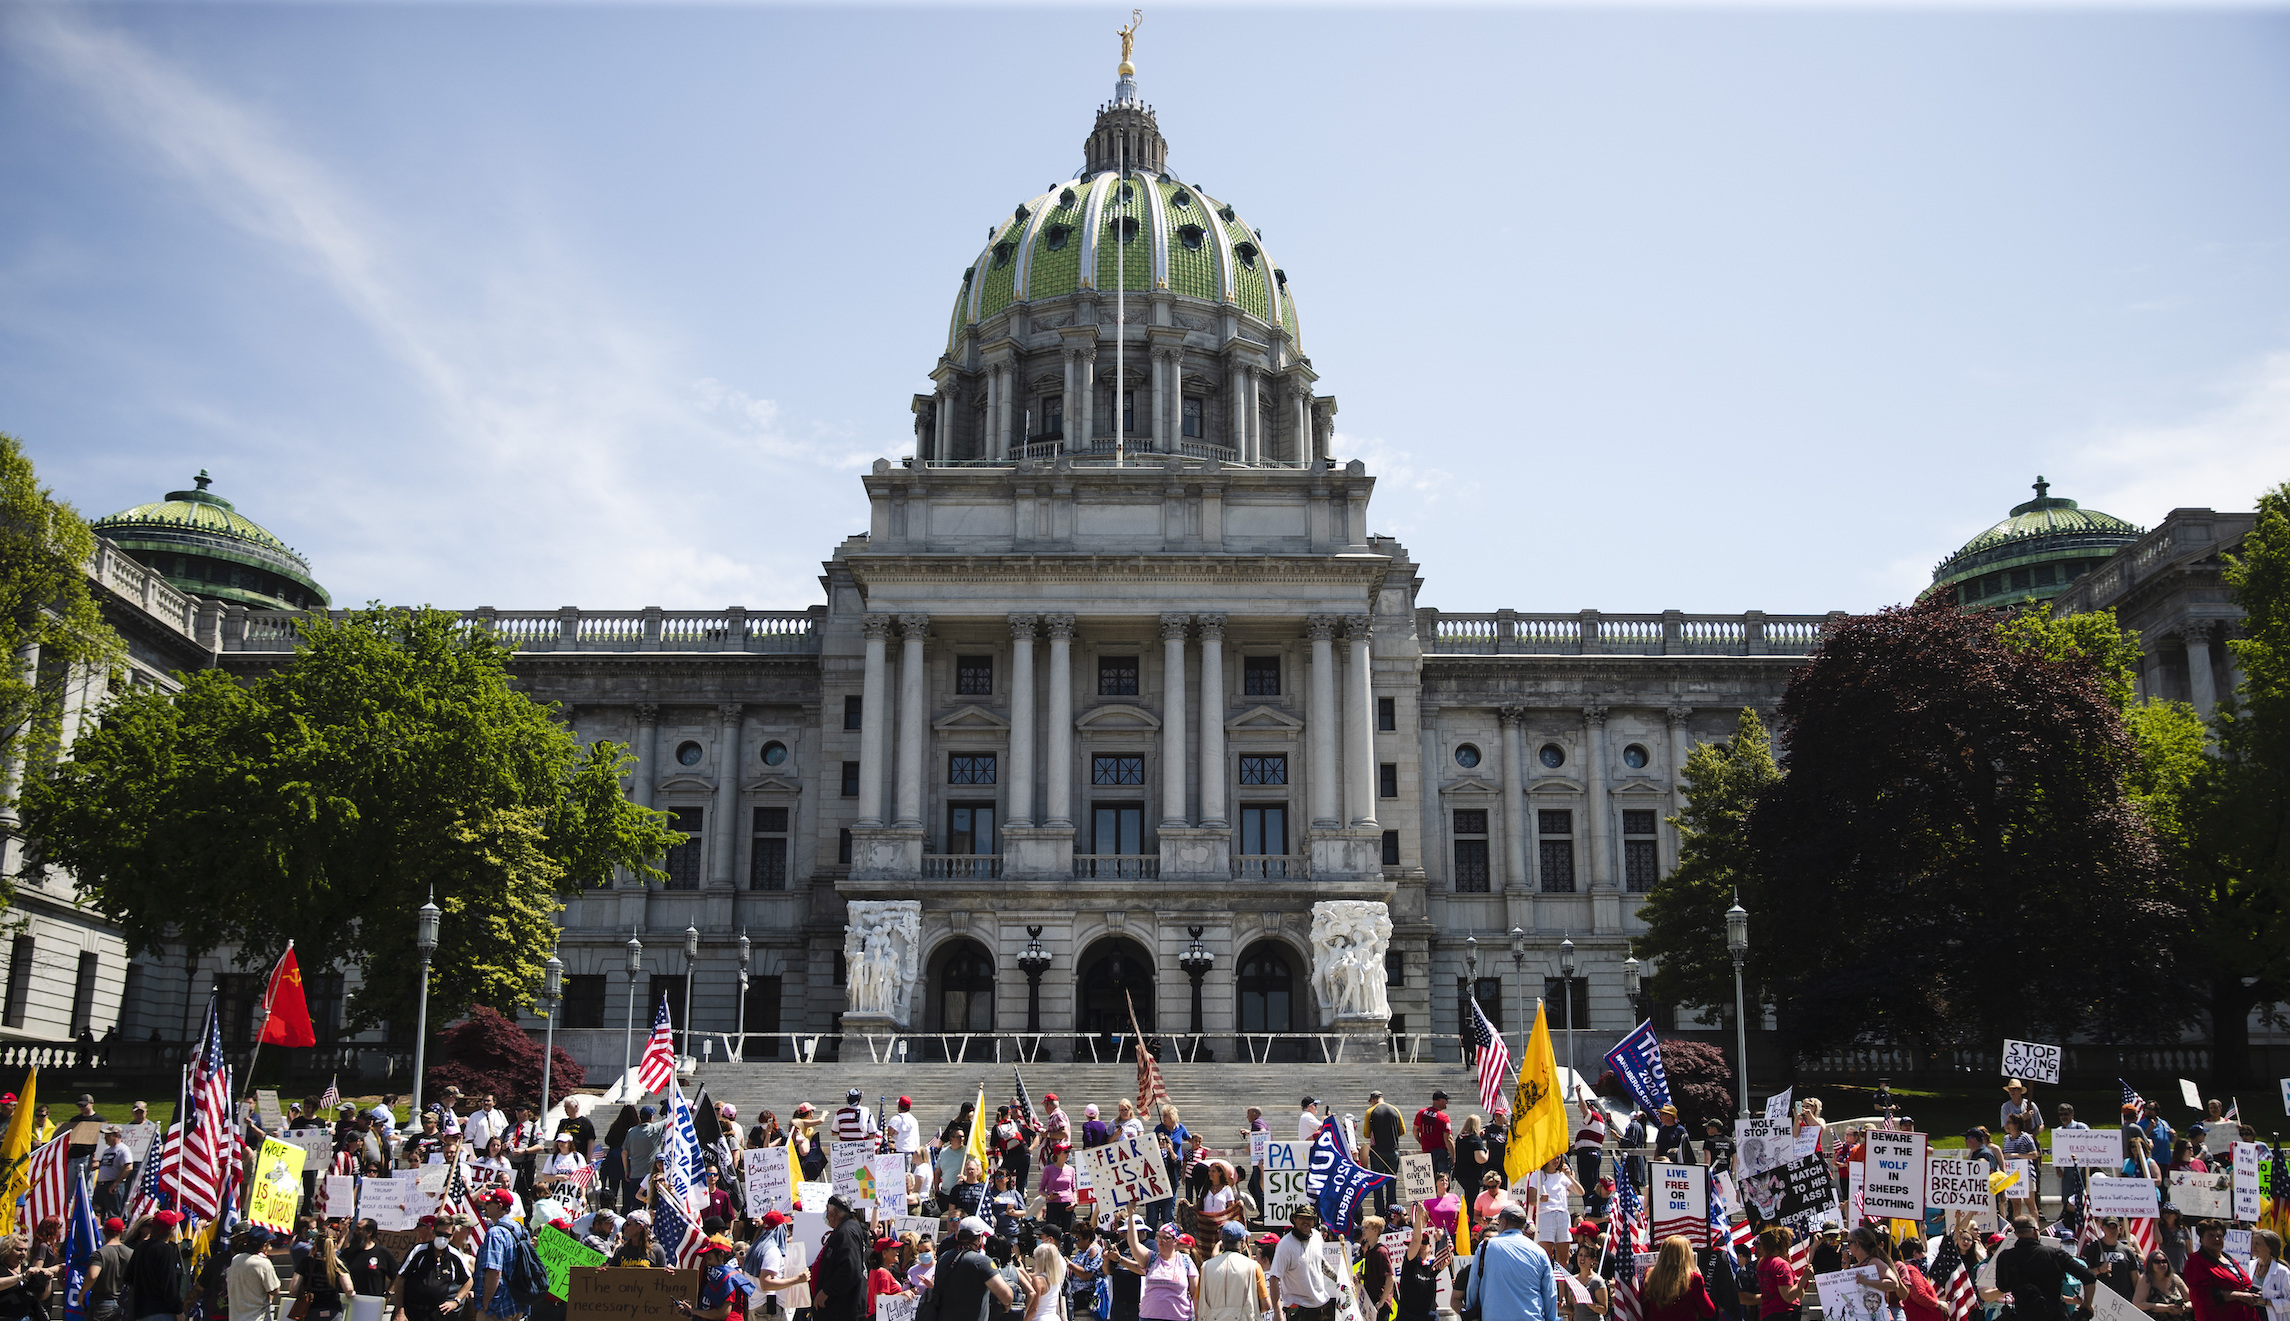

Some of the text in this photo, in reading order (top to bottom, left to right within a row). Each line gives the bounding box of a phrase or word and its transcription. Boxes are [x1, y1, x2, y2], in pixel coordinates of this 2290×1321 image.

[2009, 1043, 2057, 1059] STOP
[2004, 1064, 2058, 1082] WOLF!
[1638, 1069, 1660, 1097] 2020
[1744, 1127, 1769, 1137] STOP
[1772, 1126, 1791, 1136] THE
[1871, 1132, 1913, 1143] BEWARE
[264, 1142, 288, 1157] WOLF
[1096, 1139, 1142, 1167] FEAR
[1268, 1143, 1295, 1170] PA
[1873, 1146, 1913, 1156] OF THE
[1406, 1159, 1415, 1167] WE
[1413, 1163, 1431, 1172] DON'T
[1787, 1153, 1820, 1172] SET A
[1879, 1160, 1908, 1170] WOLF
[1931, 1160, 1981, 1175] FREE TO
[1111, 1163, 1137, 1185] IS
[1143, 1157, 1156, 1179] A
[1407, 1171, 1420, 1179] GIVE
[1666, 1169, 1687, 1178] LIVE
[1789, 1164, 1824, 1183] MATCH
[1888, 1172, 1899, 1181] IN
[256, 1182, 268, 1199] IS
[1268, 1172, 1305, 1194] SIC
[1665, 1180, 1689, 1190] FREE
[1792, 1176, 1828, 1195] TO HIS
[1869, 1184, 1909, 1195] SHEEPS
[1931, 1177, 1988, 1192] BREATHE
[1111, 1176, 1164, 1207] LIAR
[1408, 1187, 1434, 1195] THREATS
[1670, 1191, 1685, 1200] OR
[1801, 1189, 1827, 1204] ASS!
[1932, 1191, 1989, 1206] GOD'S AIR
[268, 1198, 294, 1223] VIRUS!
[1864, 1197, 1914, 1210] CLOTHING
[1779, 1200, 1836, 1227] REOPEN PA
[542, 1226, 574, 1254] ENOUGH
[581, 1276, 688, 1298] The only thing
[574, 1302, 639, 1318] necessary
